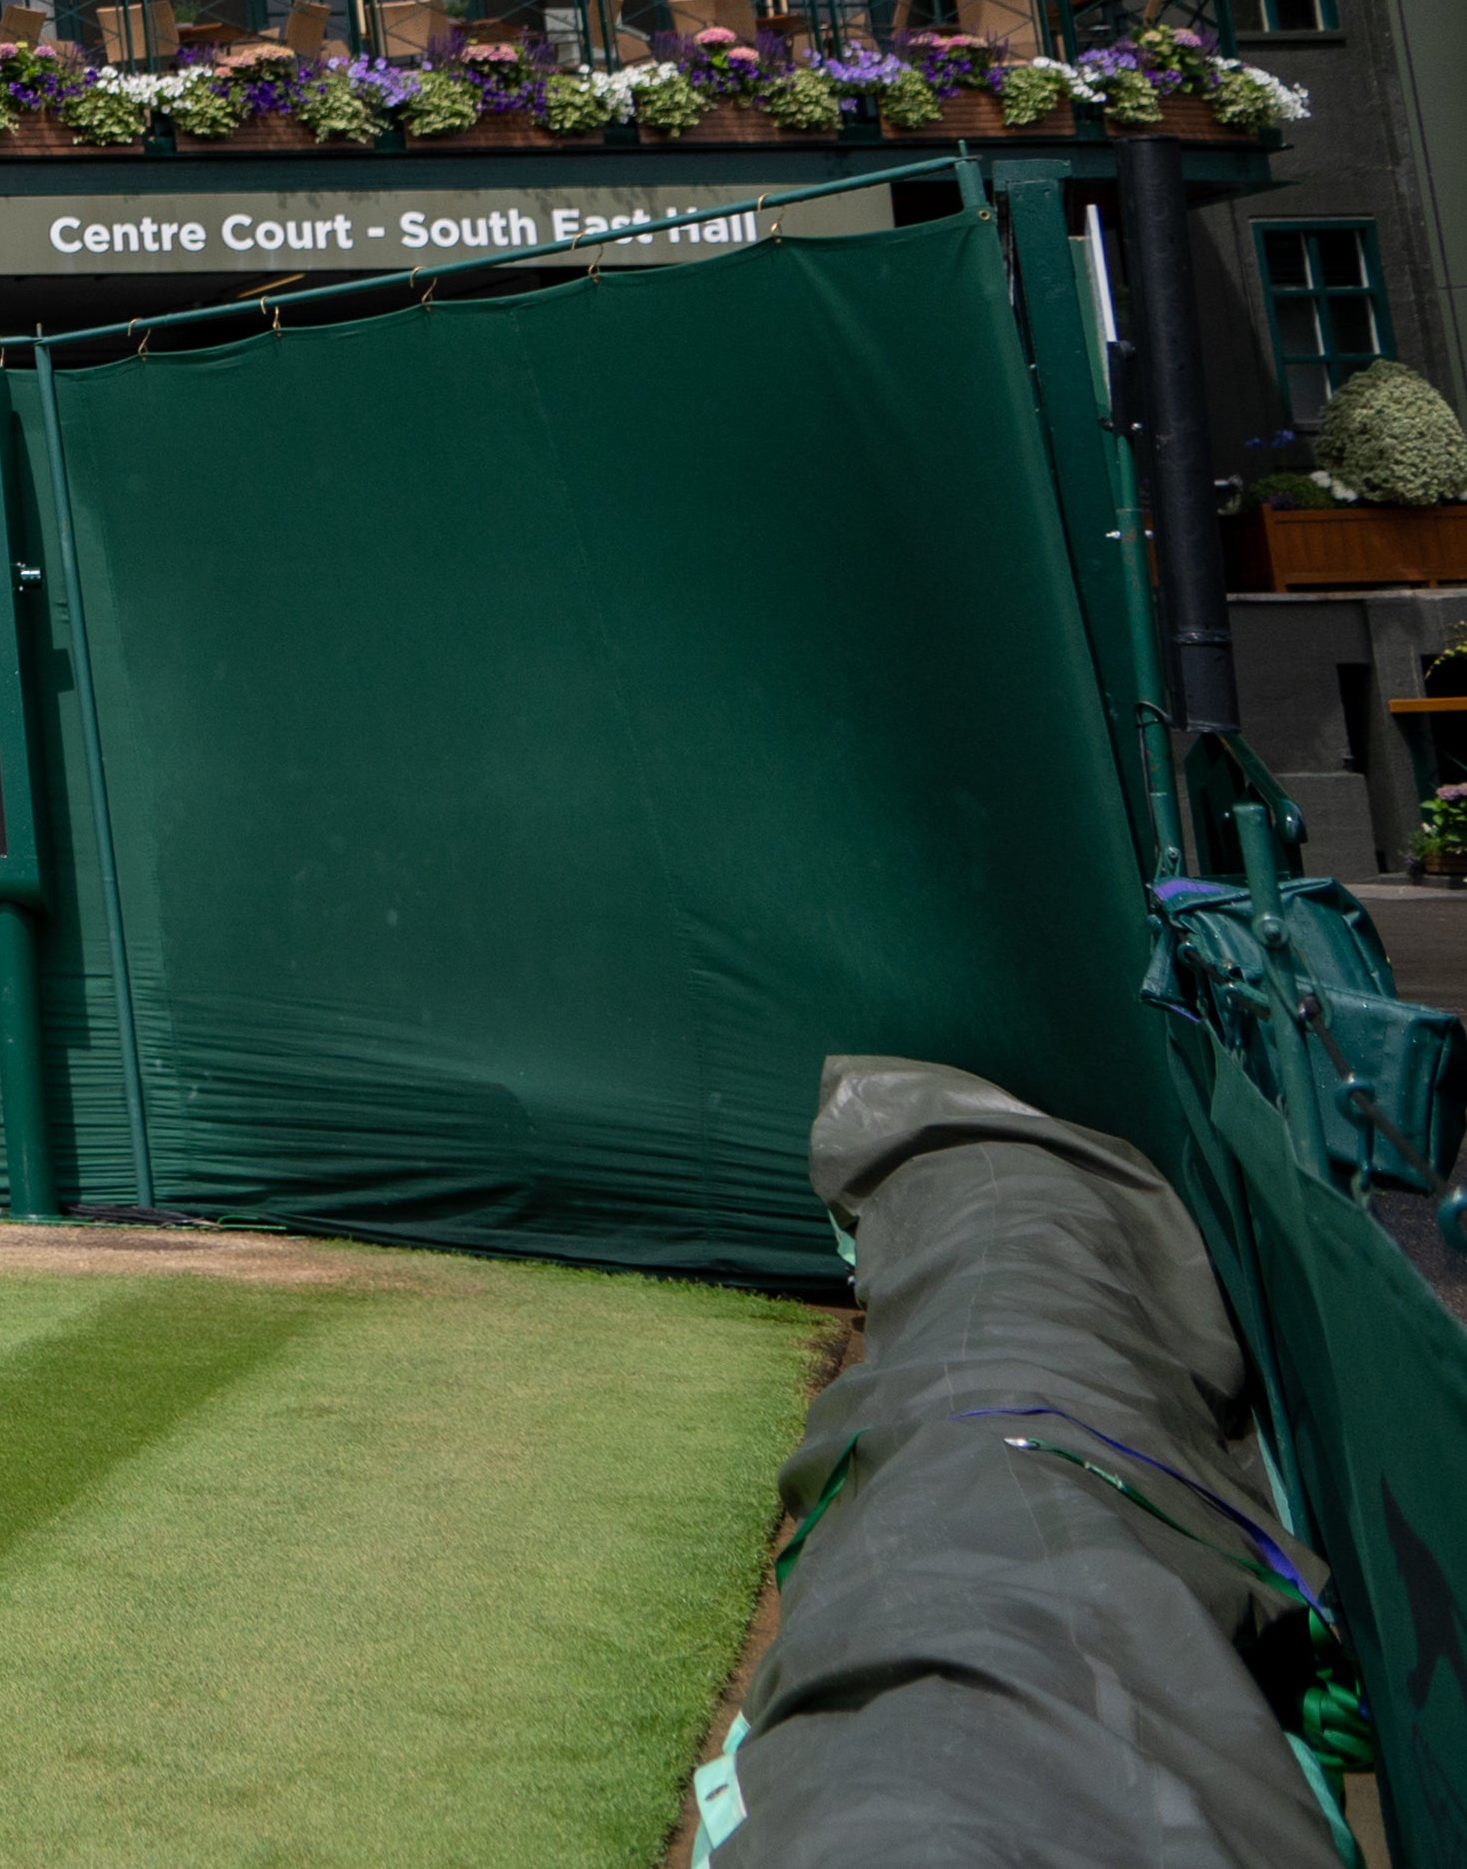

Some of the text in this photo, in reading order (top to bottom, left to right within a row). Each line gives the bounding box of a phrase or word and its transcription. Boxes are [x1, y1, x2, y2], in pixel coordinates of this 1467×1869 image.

[49, 216, 206, 253] Centre
[221, 214, 353, 251] Court
[400, 208, 537, 248] South
[552, 208, 654, 245] East
[666, 207, 758, 244] Hall
